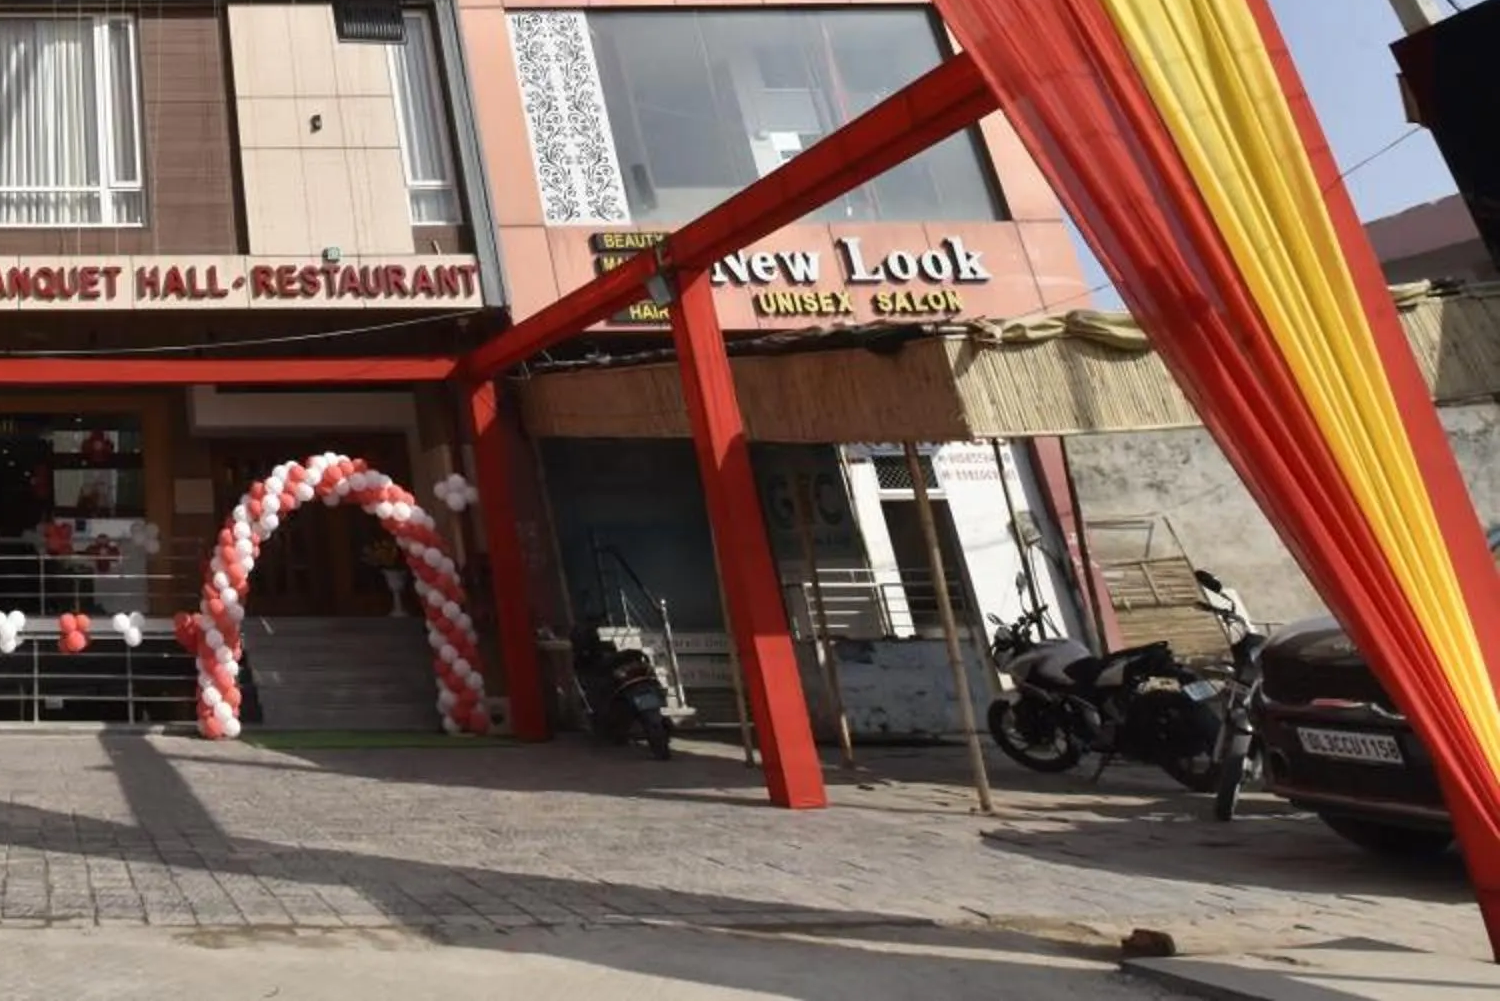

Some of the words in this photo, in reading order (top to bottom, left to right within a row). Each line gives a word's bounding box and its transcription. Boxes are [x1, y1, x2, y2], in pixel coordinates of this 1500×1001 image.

[603, 233, 664, 249] BEAUTY
[710, 248, 821, 283] New
[840, 236, 993, 283] Look
[135, 265, 229, 301] HALL
[248, 264, 479, 301] RESTAURANT
[756, 292, 854, 315] UNISEX
[873, 290, 964, 314] SALON
